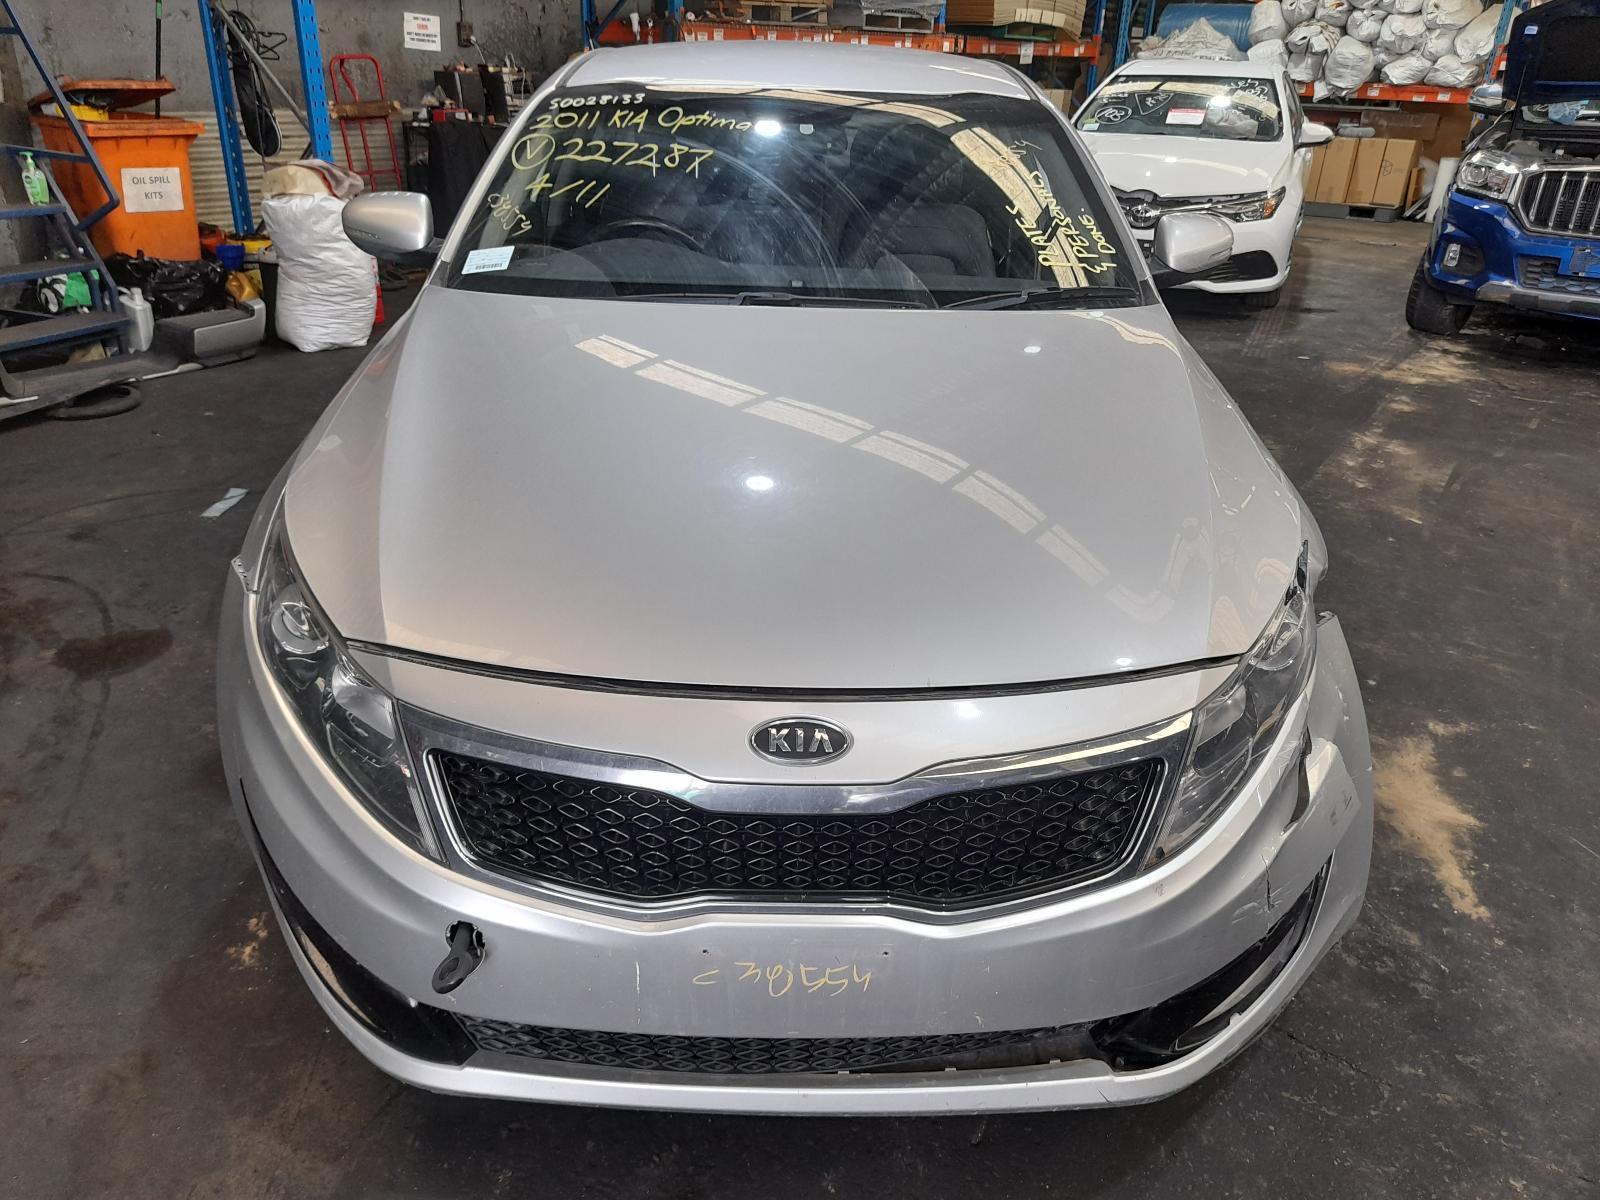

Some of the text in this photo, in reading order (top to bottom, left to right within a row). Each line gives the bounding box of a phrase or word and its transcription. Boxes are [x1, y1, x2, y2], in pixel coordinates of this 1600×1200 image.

[529, 106, 753, 134] 2011 KIA Optima
[554, 138, 714, 174] 227287
[131, 176, 171, 185] OIL SPILL
[144, 191, 164, 200] KITS
[767, 727, 834, 753] KIA
